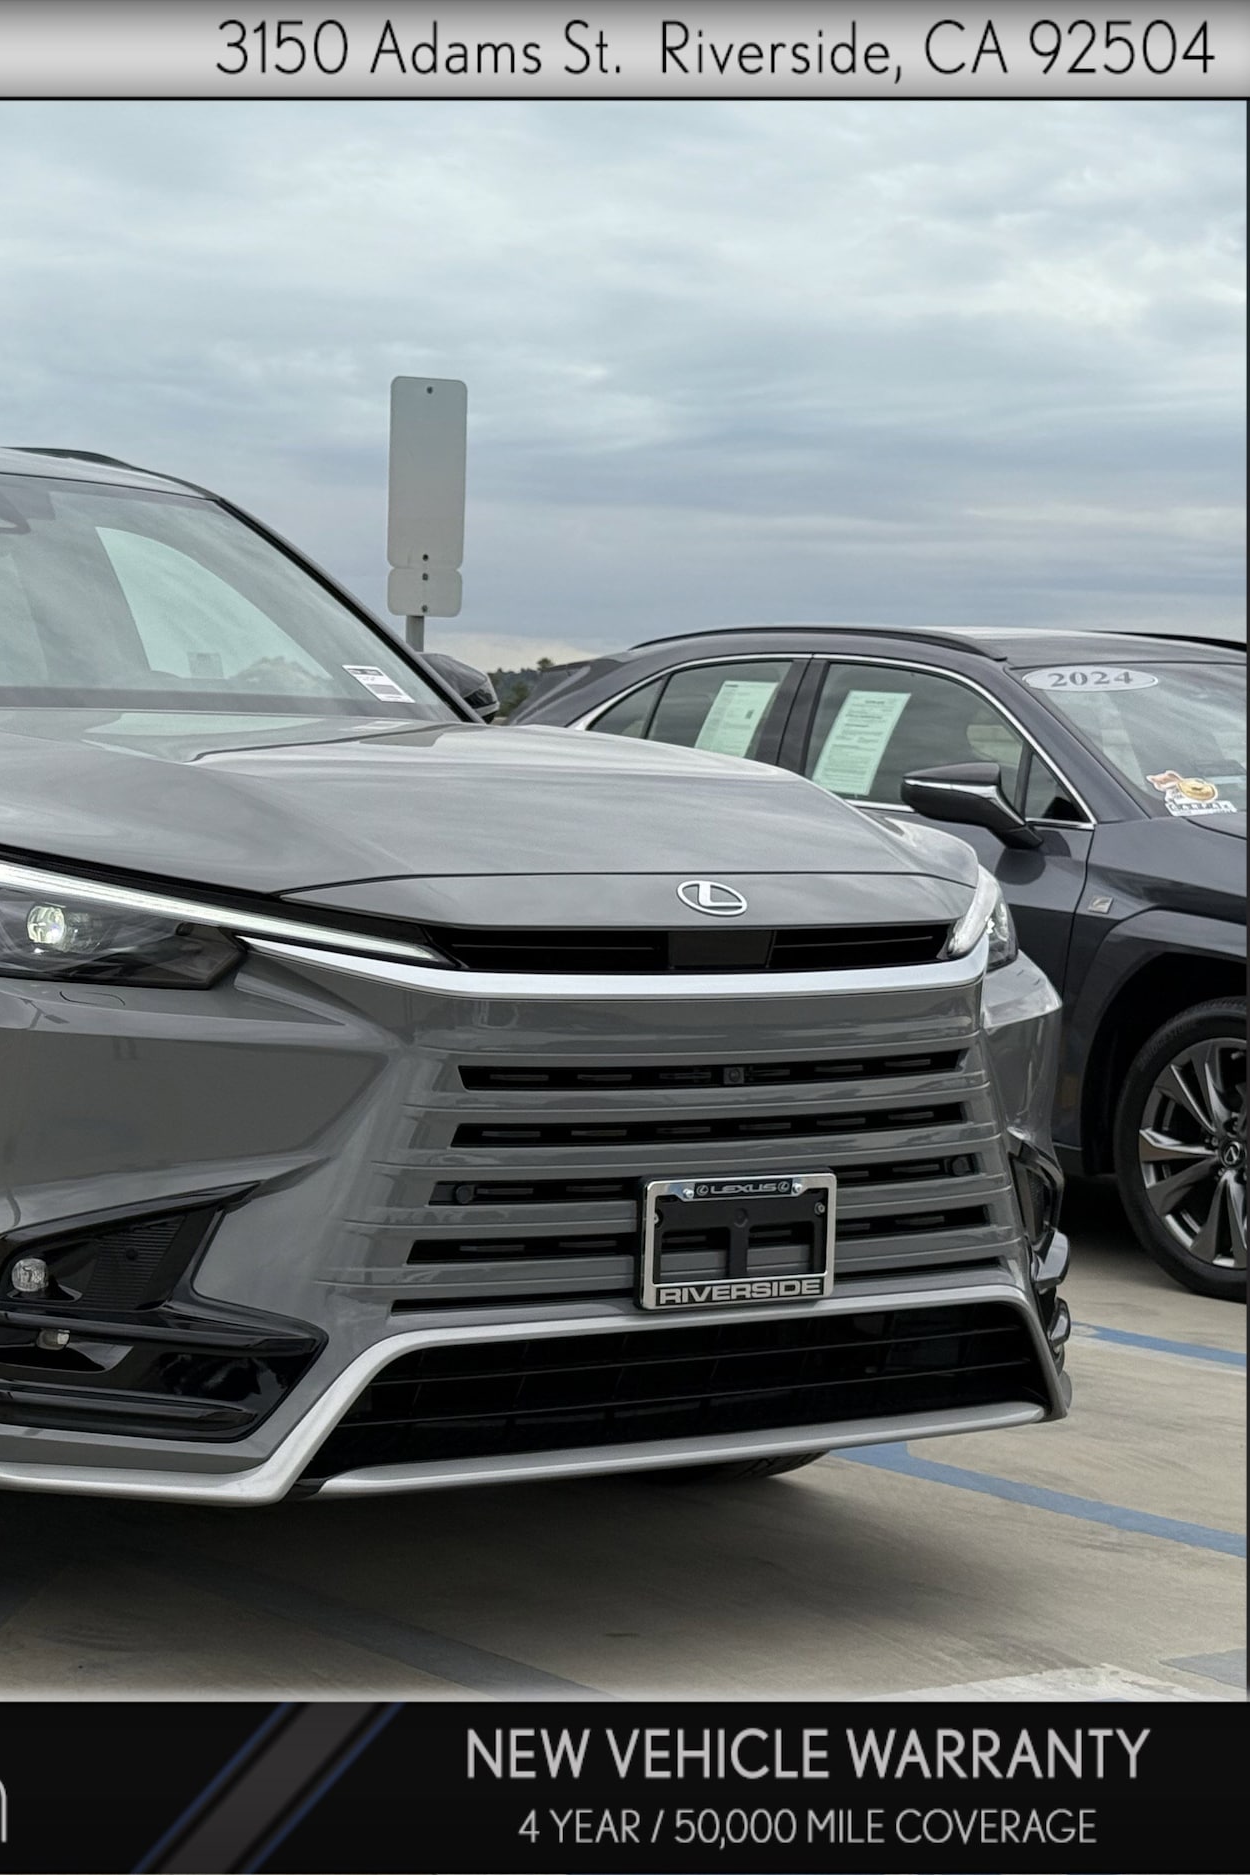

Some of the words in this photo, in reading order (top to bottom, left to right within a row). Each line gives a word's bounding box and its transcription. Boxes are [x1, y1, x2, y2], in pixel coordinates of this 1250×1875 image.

[1047, 671, 1133, 688] 2024
[710, 1183, 778, 1195] LEXUS
[659, 1279, 821, 1304] RIVERSIDE
